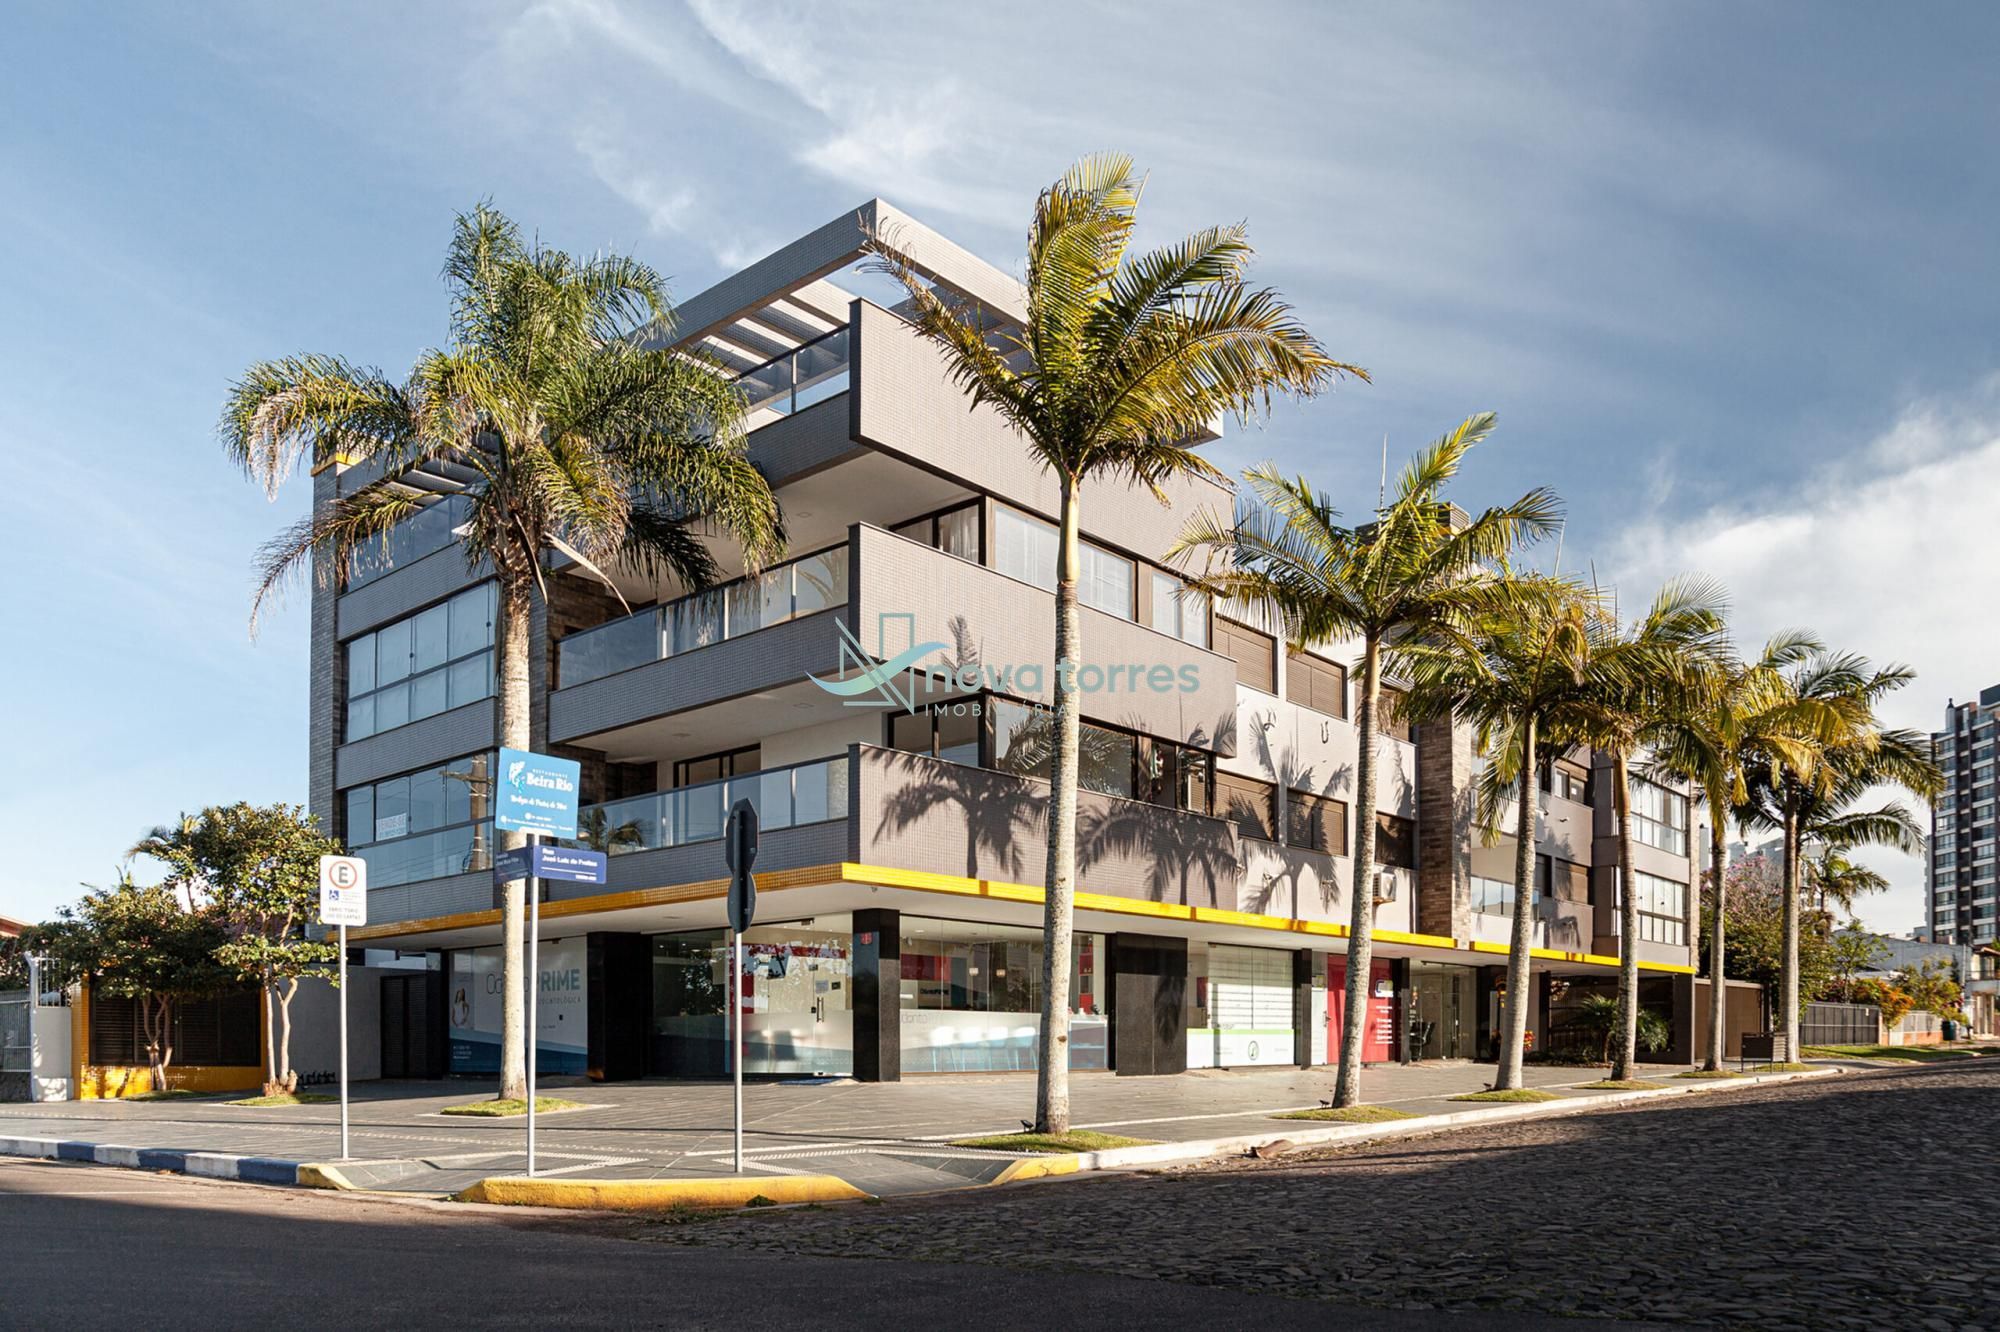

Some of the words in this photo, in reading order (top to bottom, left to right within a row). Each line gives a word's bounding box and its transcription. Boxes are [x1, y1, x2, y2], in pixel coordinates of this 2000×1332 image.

[526, 772, 555, 790] Beira
[555, 777, 574, 793] Rio
[338, 866, 349, 884] E
